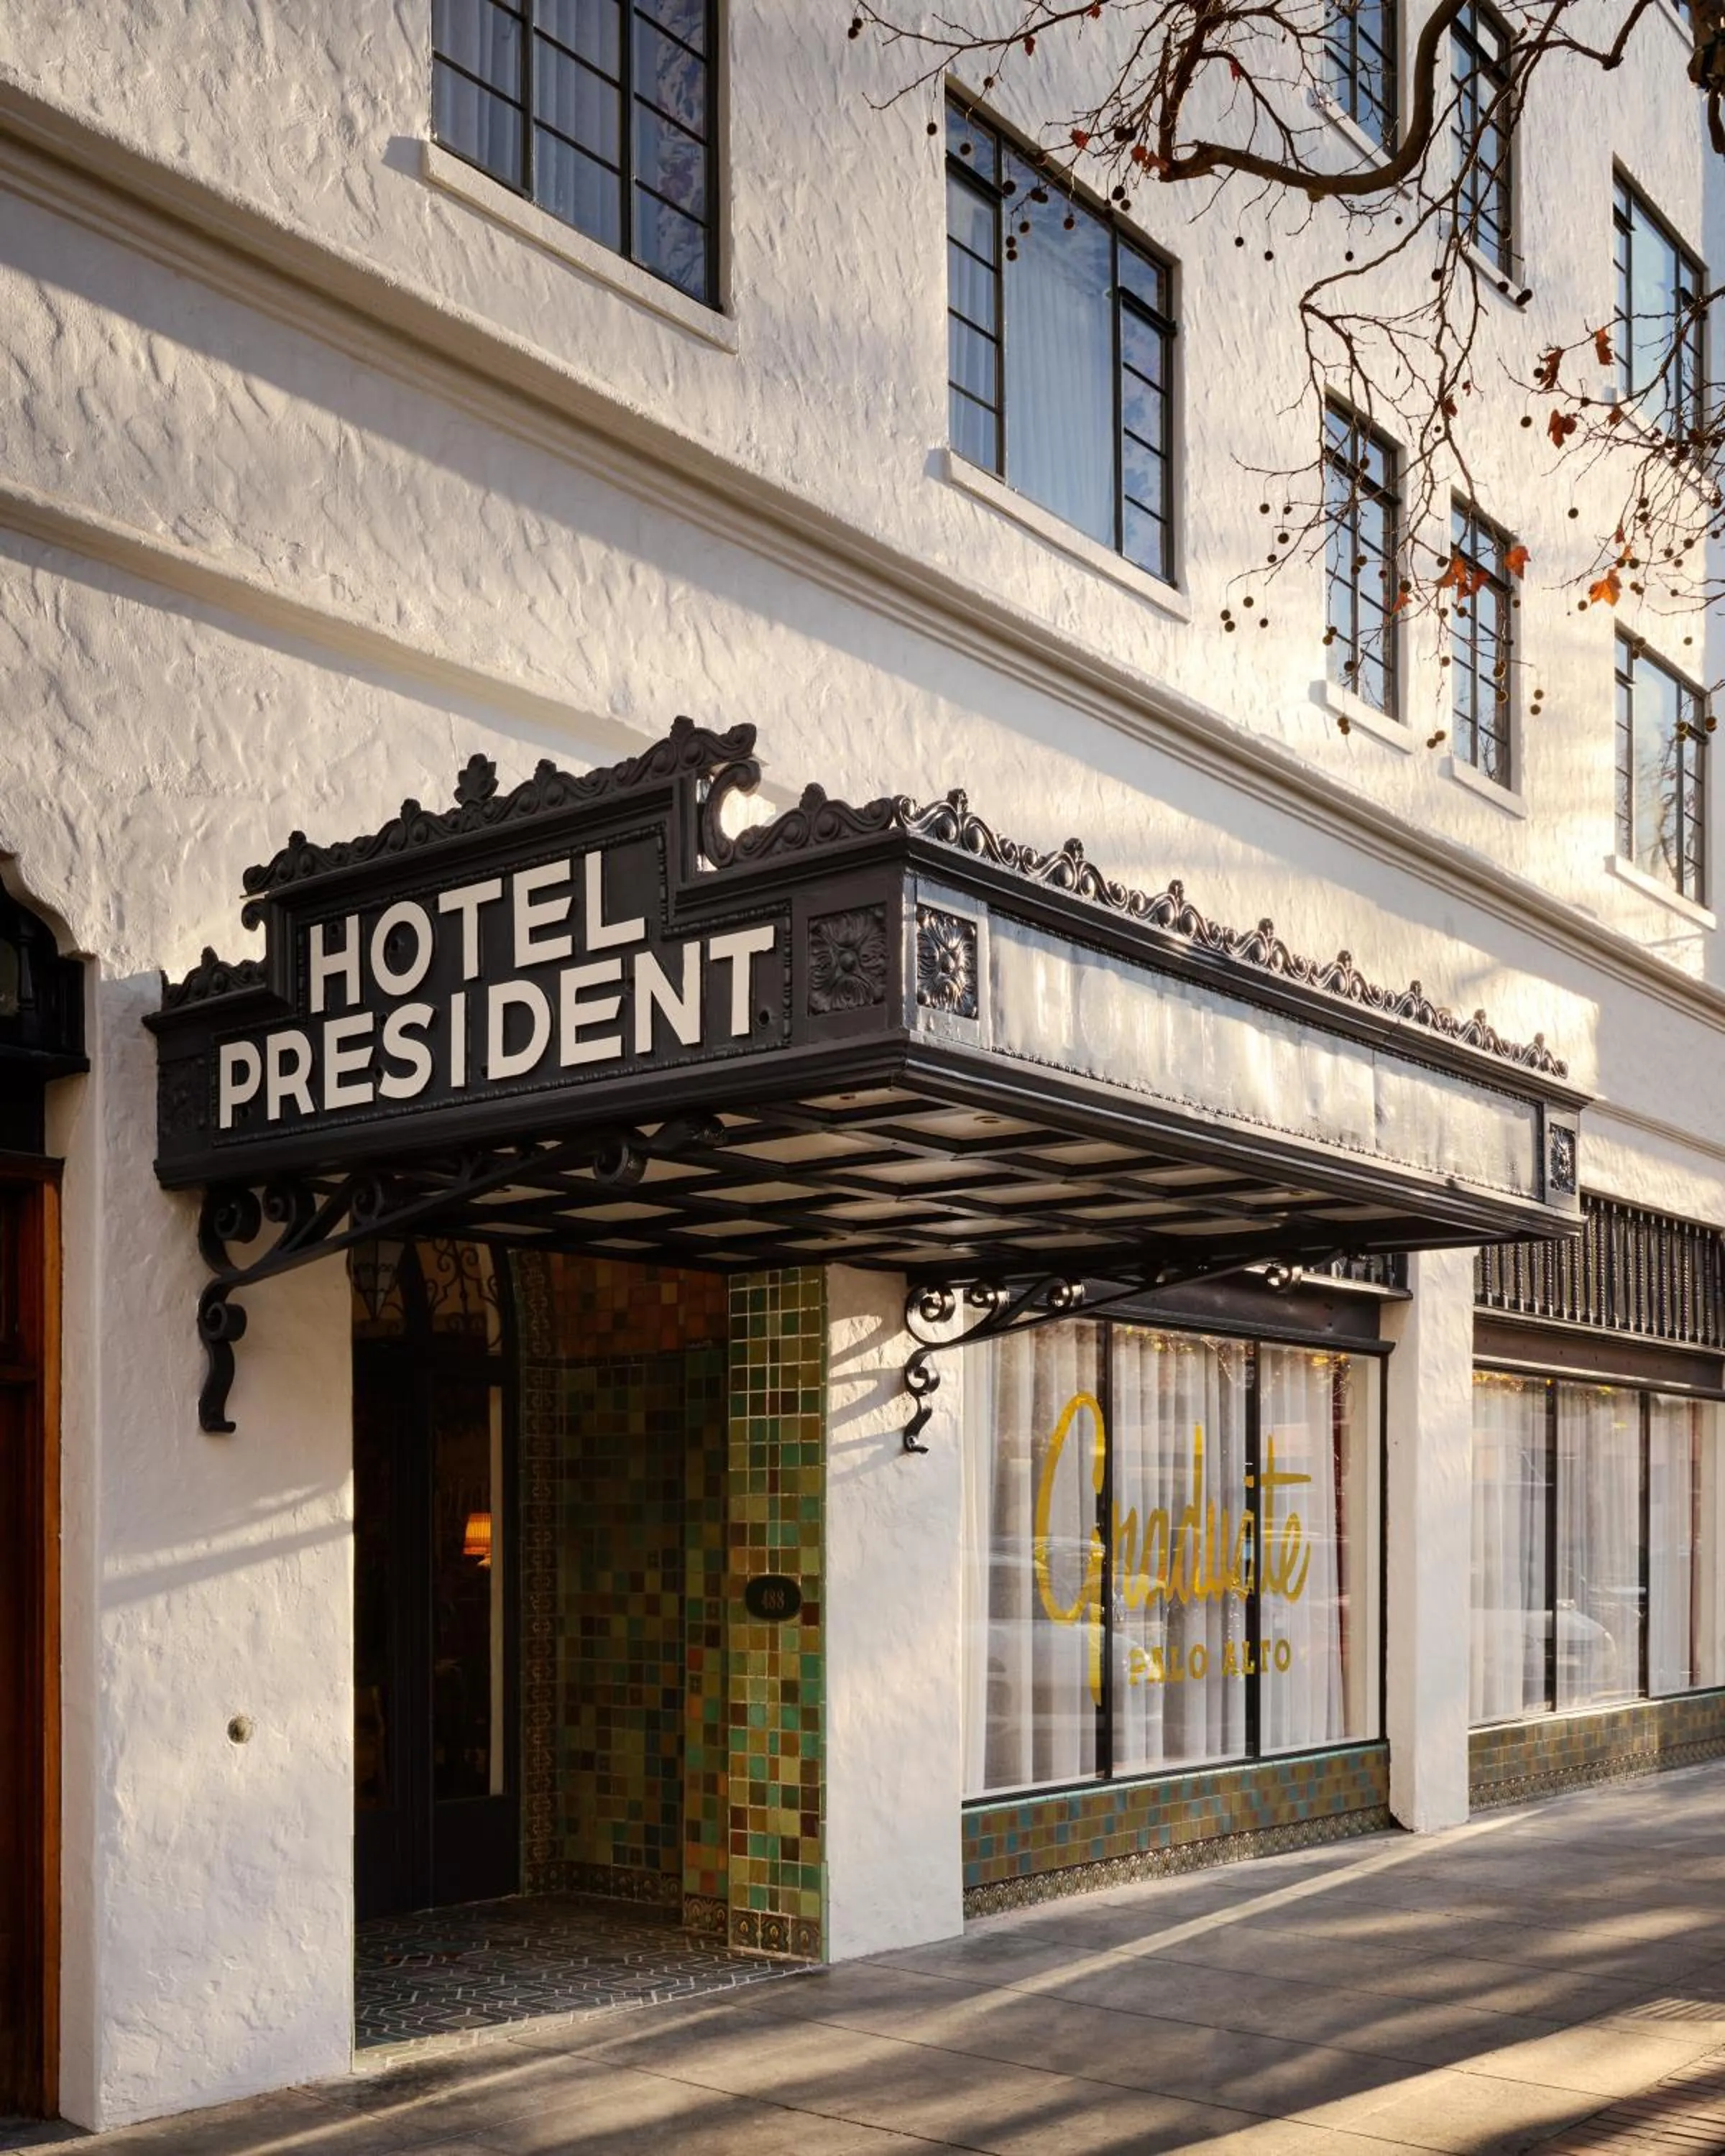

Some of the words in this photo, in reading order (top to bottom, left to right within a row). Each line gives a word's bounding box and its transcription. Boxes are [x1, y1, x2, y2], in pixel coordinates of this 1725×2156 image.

[310, 851, 645, 1013] HOTEL
[218, 925, 775, 1129] PRESIDENT
[1034, 1391, 1312, 1707] Graduate
[1128, 1644, 1209, 1686] PALO
[1222, 1638, 1291, 1677] ALTO
